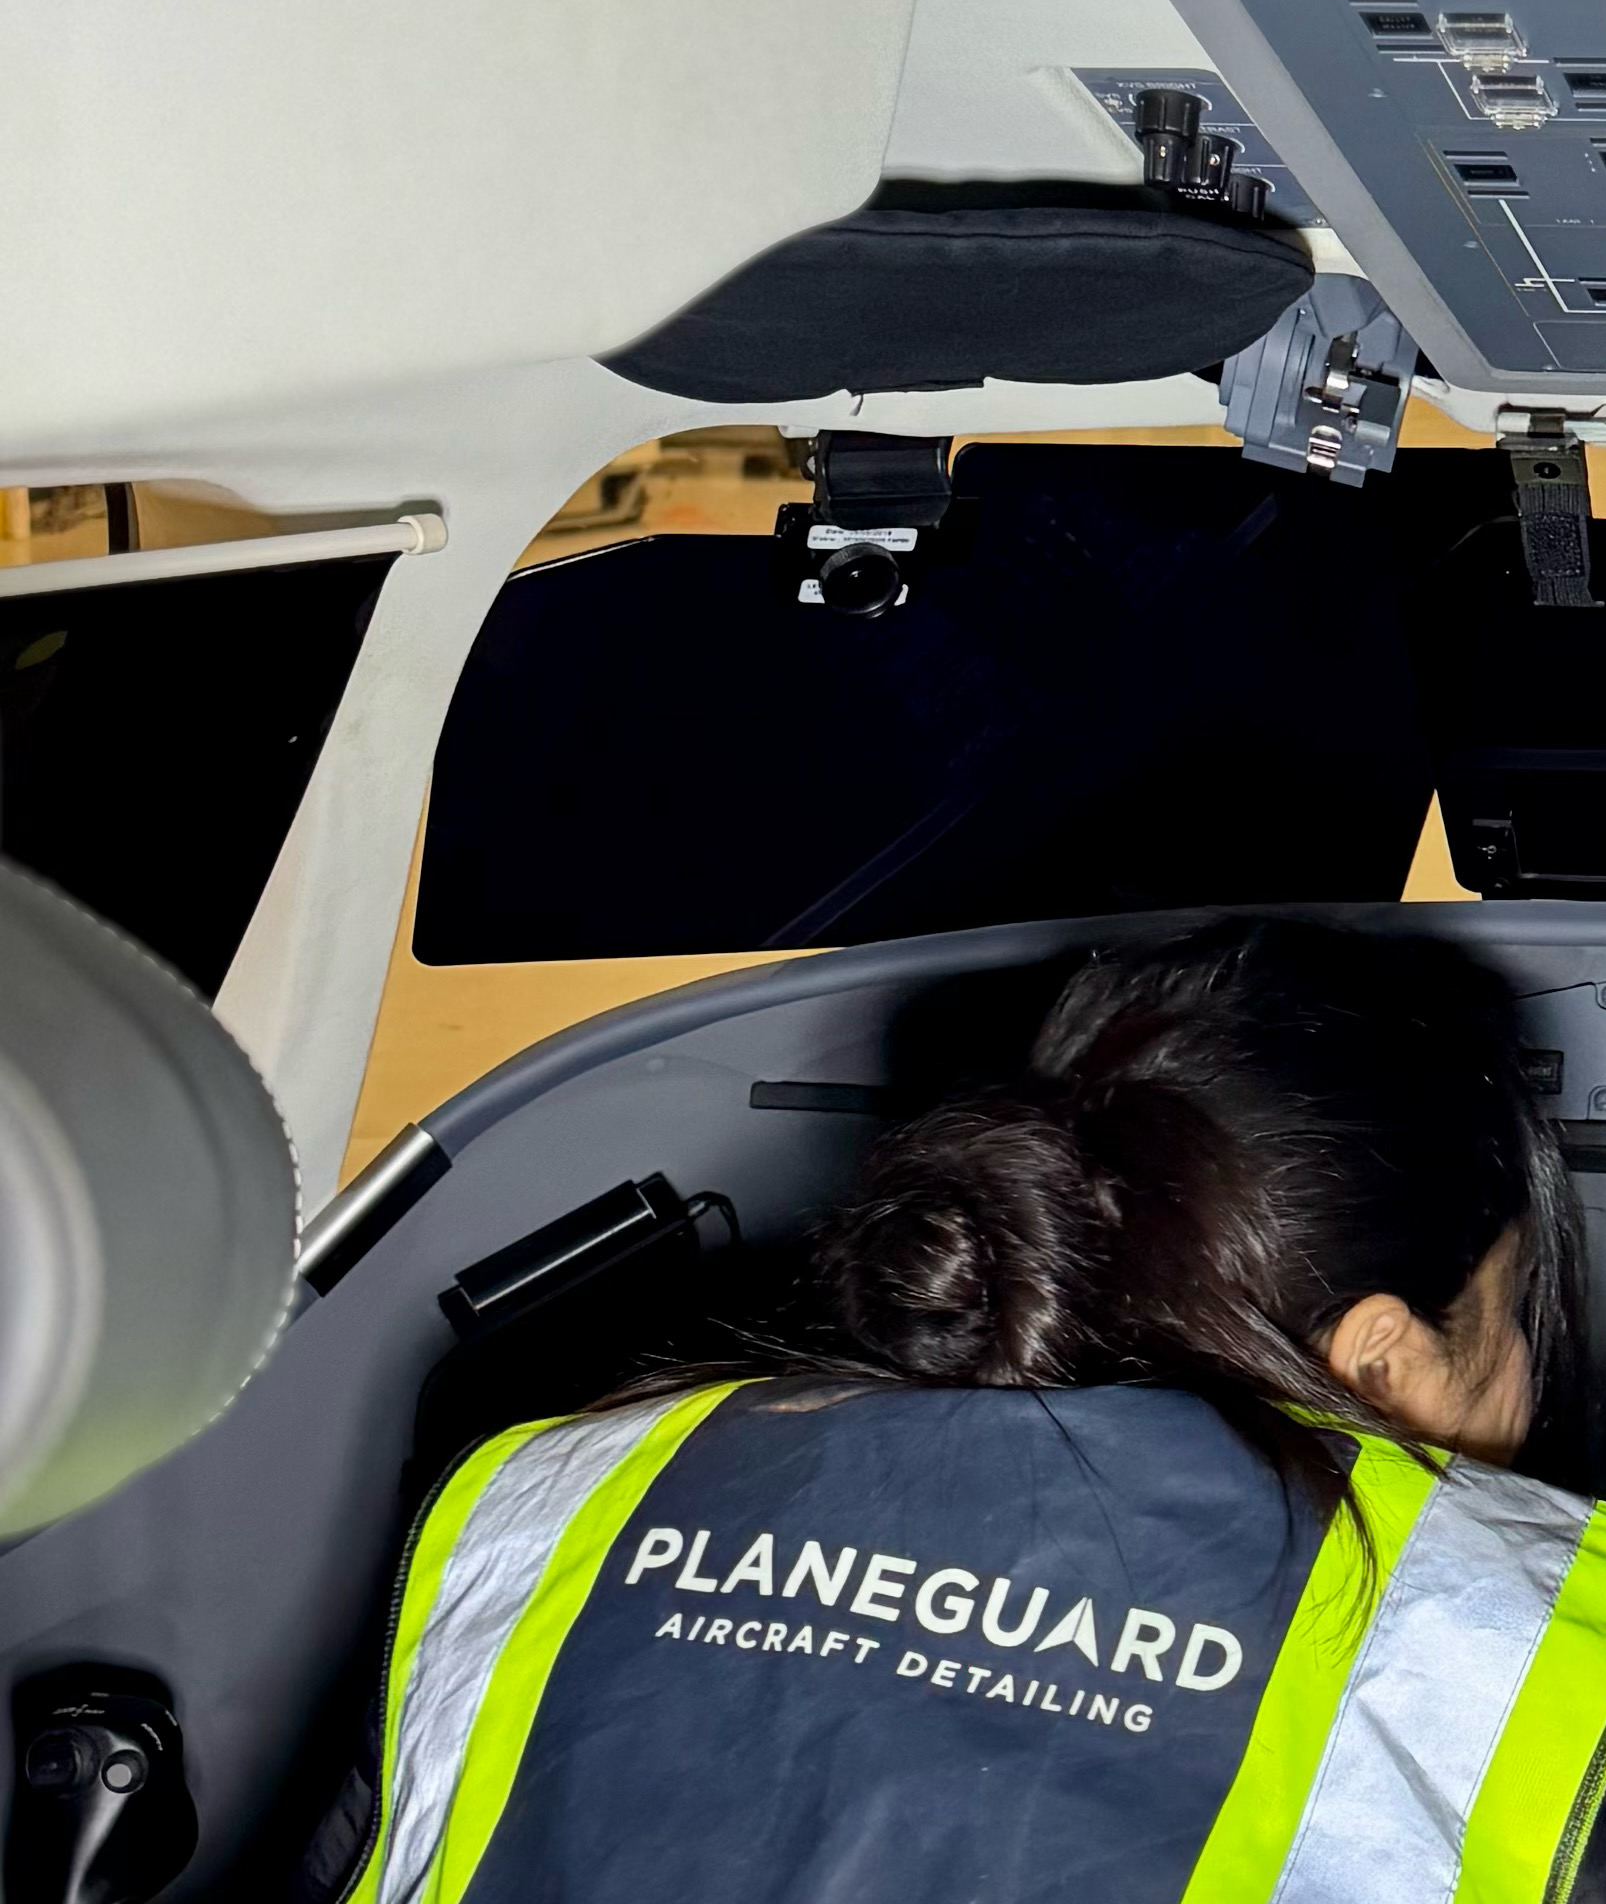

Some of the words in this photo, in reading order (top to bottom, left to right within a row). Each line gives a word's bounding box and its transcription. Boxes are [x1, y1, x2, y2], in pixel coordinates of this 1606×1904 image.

[624, 1526, 1244, 1693] PLANEGUARD
[655, 1612, 881, 1666] AIRCRAFT
[896, 1649, 1154, 1735] DETAILING
